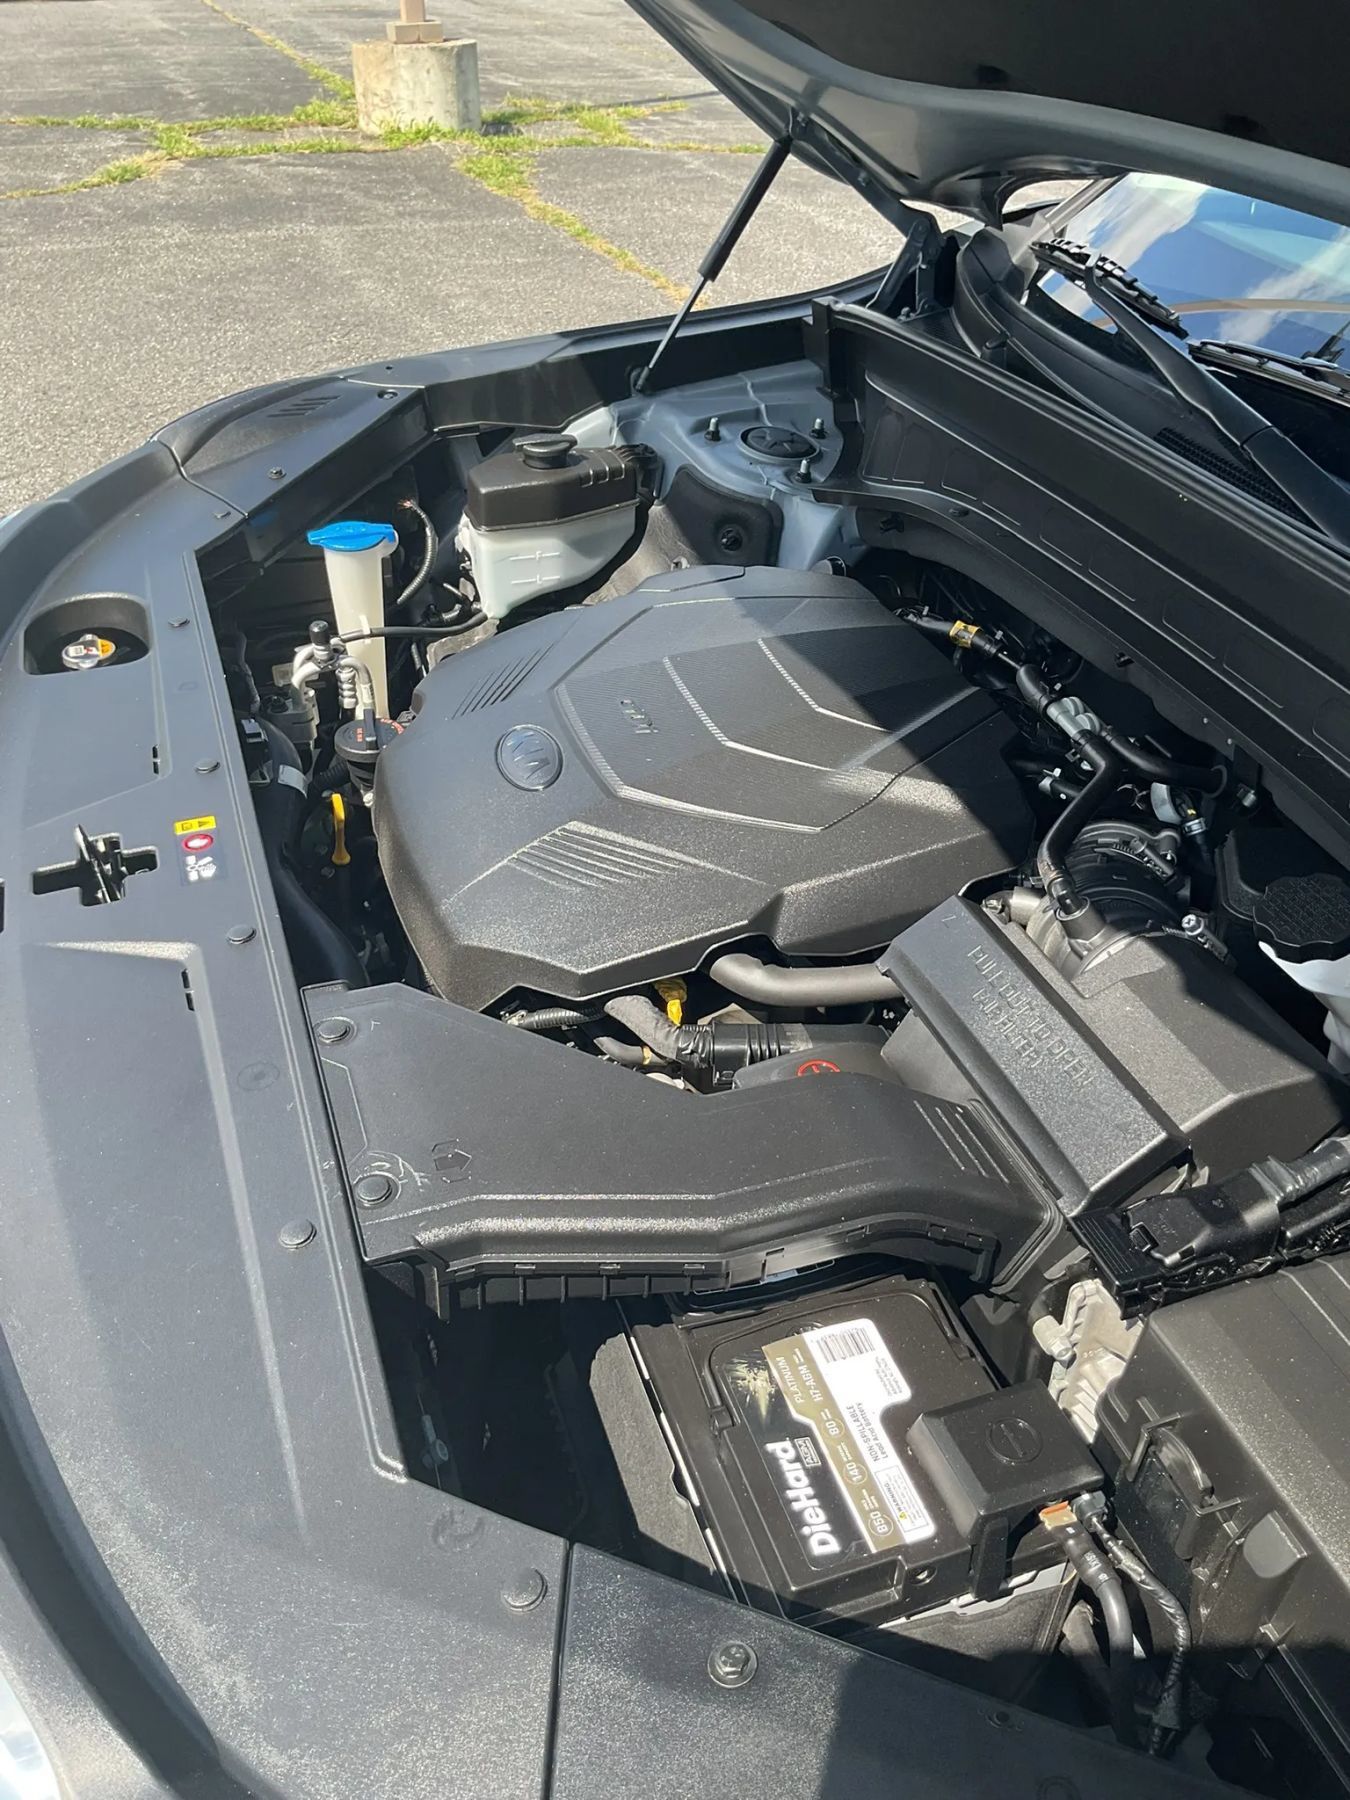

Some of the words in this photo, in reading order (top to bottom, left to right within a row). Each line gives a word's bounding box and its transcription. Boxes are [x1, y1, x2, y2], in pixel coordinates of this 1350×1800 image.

[967, 945, 1004, 988] PULL
[999, 983, 1032, 1018] OUT
[776, 1356, 802, 1403] PLATINUM
[800, 1364, 824, 1402] H7-AGM
[825, 1420, 840, 1436] 80
[855, 1403, 872, 1427] Battery
[846, 1405, 880, 1462] NON-SPILLABLE
[875, 1445, 888, 1459] Lead
[845, 1462, 863, 1482] 140
[765, 1440, 841, 1556] DieHard
[869, 1511, 889, 1533] 850
